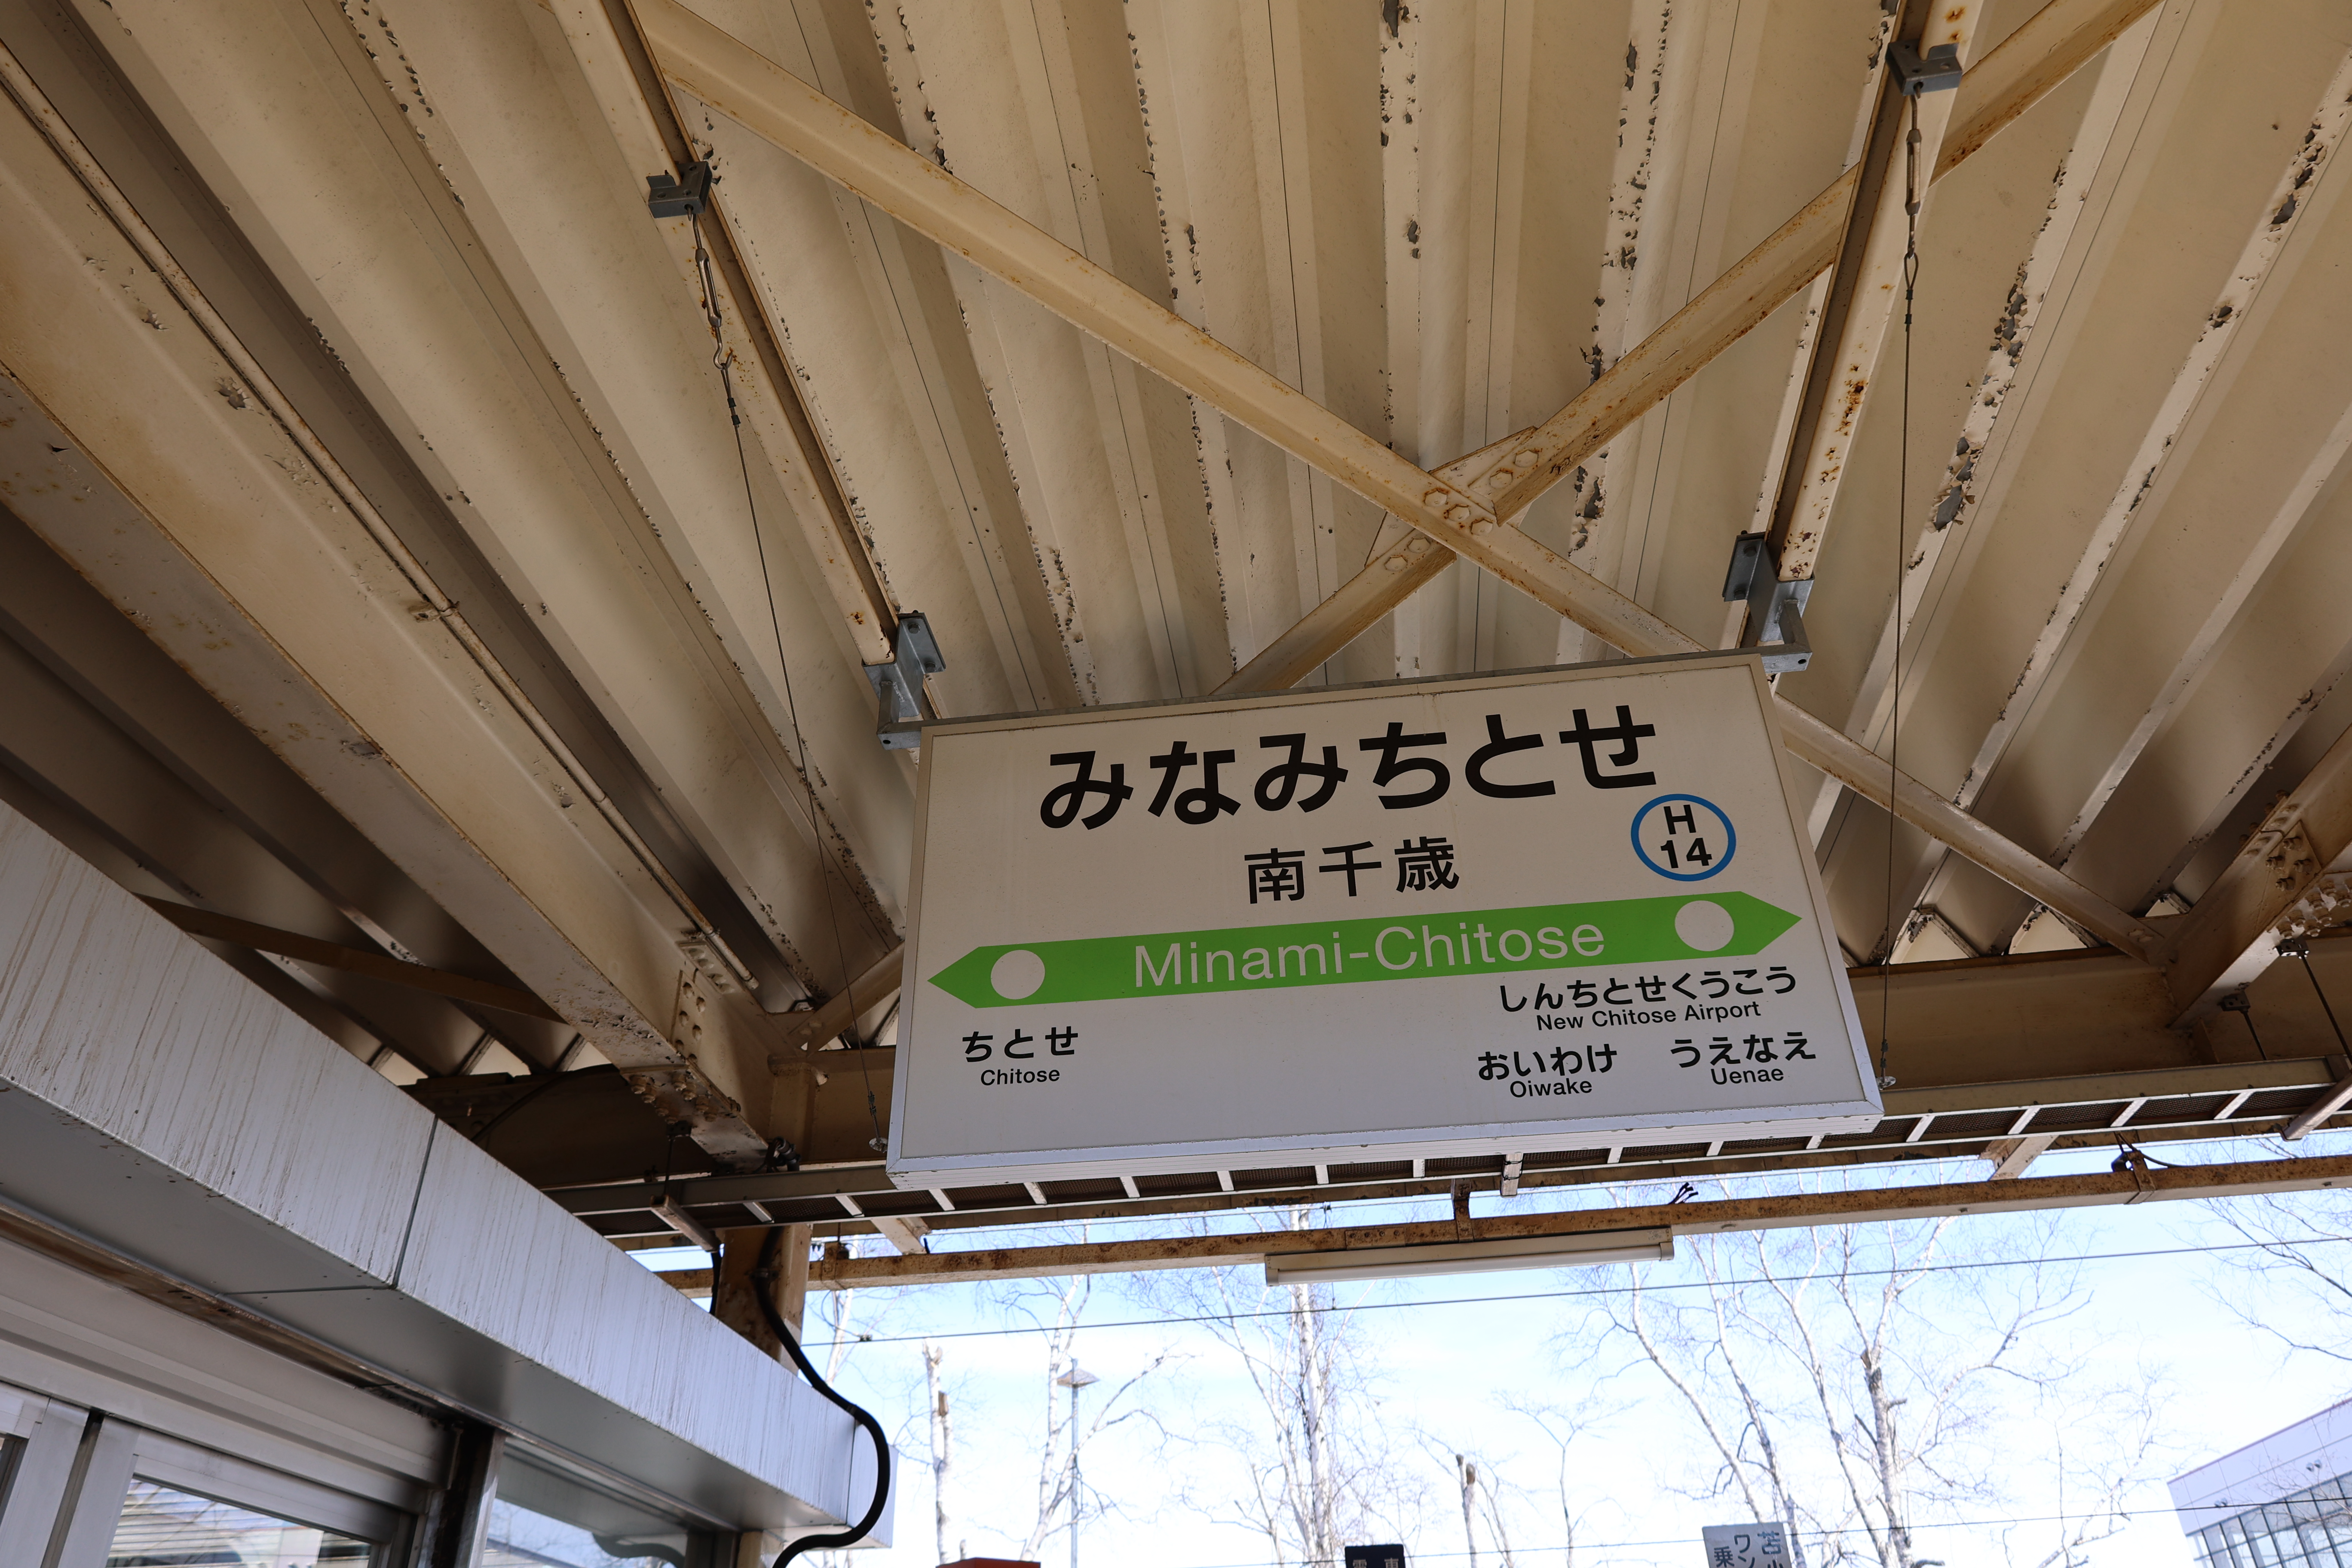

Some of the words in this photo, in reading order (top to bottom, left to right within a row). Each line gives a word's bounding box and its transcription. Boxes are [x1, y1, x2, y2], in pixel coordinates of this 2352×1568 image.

[1040, 705, 1656, 830] みなみちとせ
[1663, 805, 1696, 835] H
[1244, 836, 1459, 904] 南千歳
[1660, 838, 1712, 868] 14
[1136, 923, 1605, 987] Minami-Chitose
[1500, 966, 1796, 1012] しんちとせくうこう
[1537, 1014, 1583, 1031] New
[1592, 1009, 1676, 1027] Chitose
[1685, 1001, 1761, 1023] Airport
[962, 1026, 1078, 1062] ちとせ
[1670, 1032, 1816, 1068] うえなえ
[981, 1069, 1060, 1086] Chitose
[1478, 1044, 1617, 1081] おいわけ
[1711, 1068, 1784, 1085] Uenae
[1510, 1078, 1592, 1098] Oiwake
